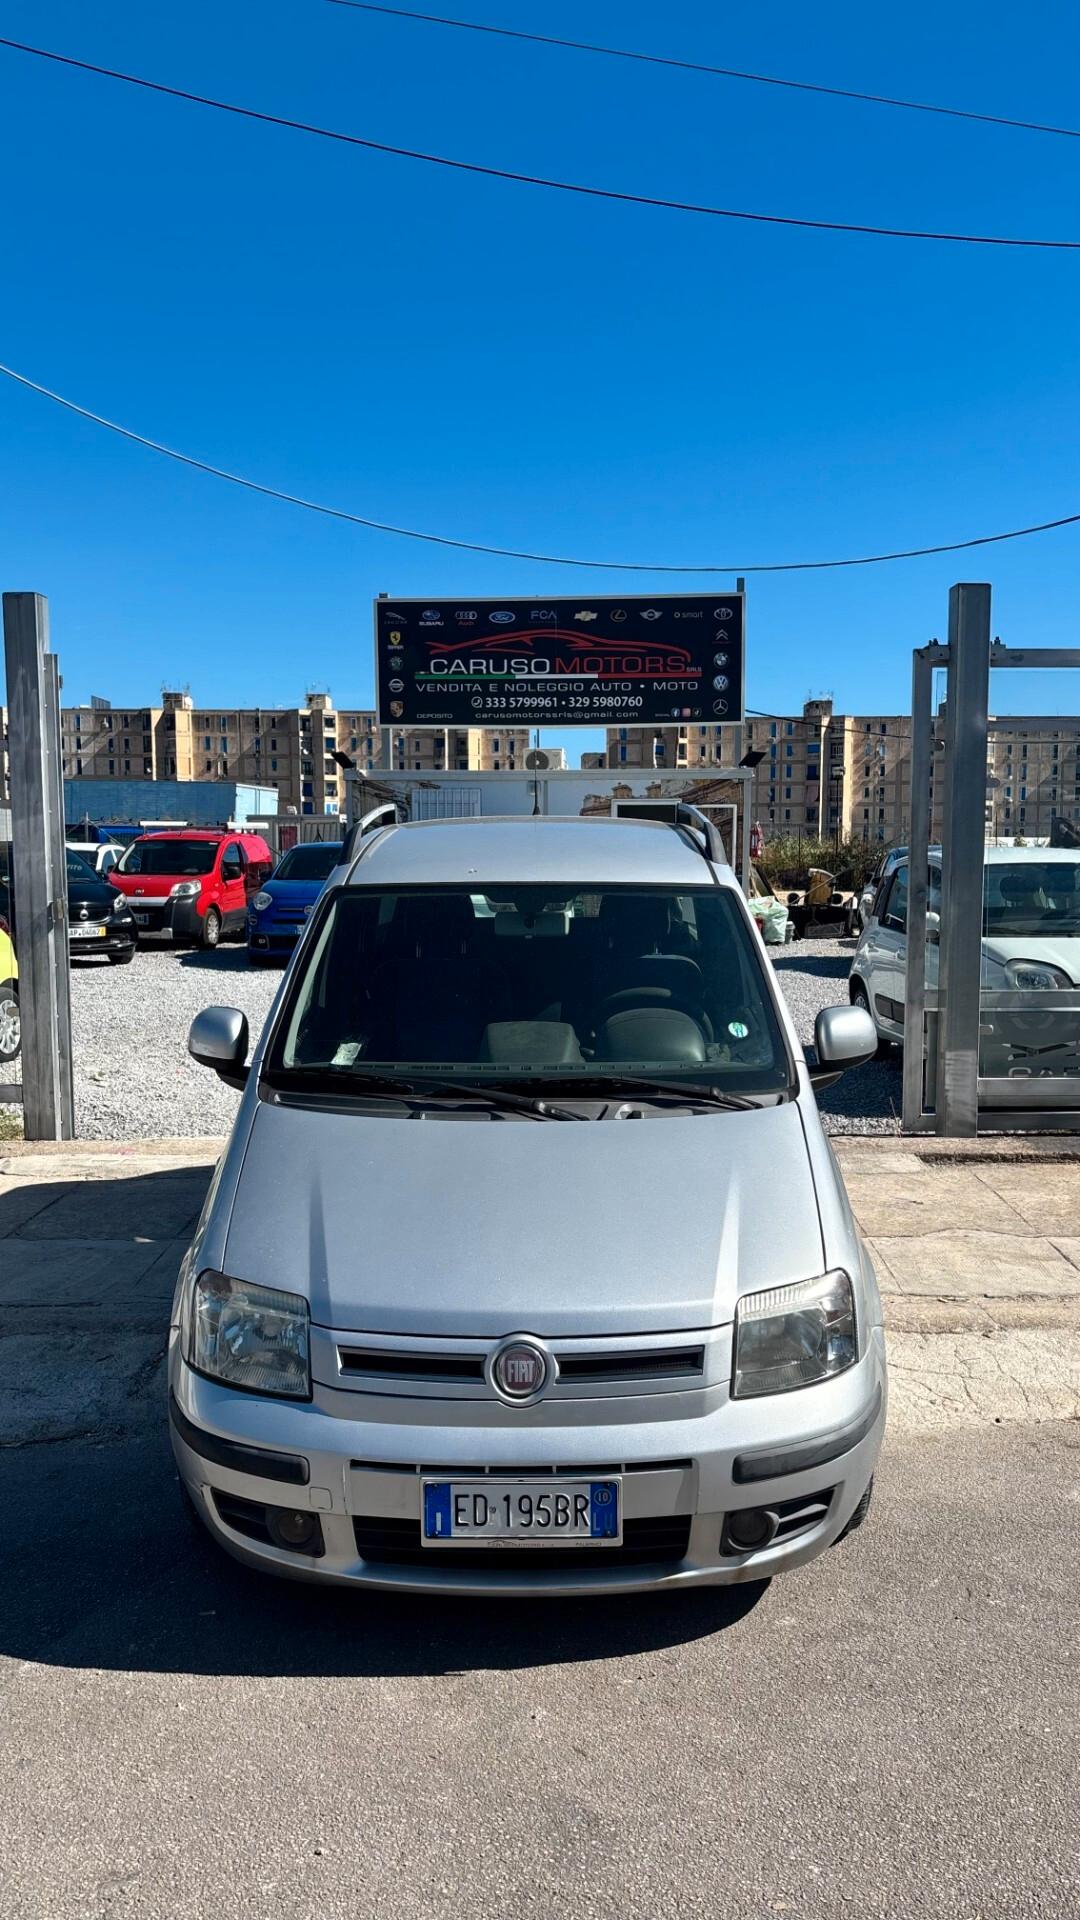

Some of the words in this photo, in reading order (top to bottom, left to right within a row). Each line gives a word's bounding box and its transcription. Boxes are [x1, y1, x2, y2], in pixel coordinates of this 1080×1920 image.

[530, 610, 557, 620] FCA
[415, 683, 483, 693] VENDITA
[489, 683, 499, 693] E
[504, 682, 585, 693] NOLEGGIO
[590, 682, 632, 692] AUTO
[653, 681, 699, 691] MOTO
[485, 697, 507, 708] 333
[508, 697, 558, 708] 5799961
[568, 697, 590, 708] 329
[592, 696, 643, 708] 5980760
[507, 1360, 535, 1383] FIAT
